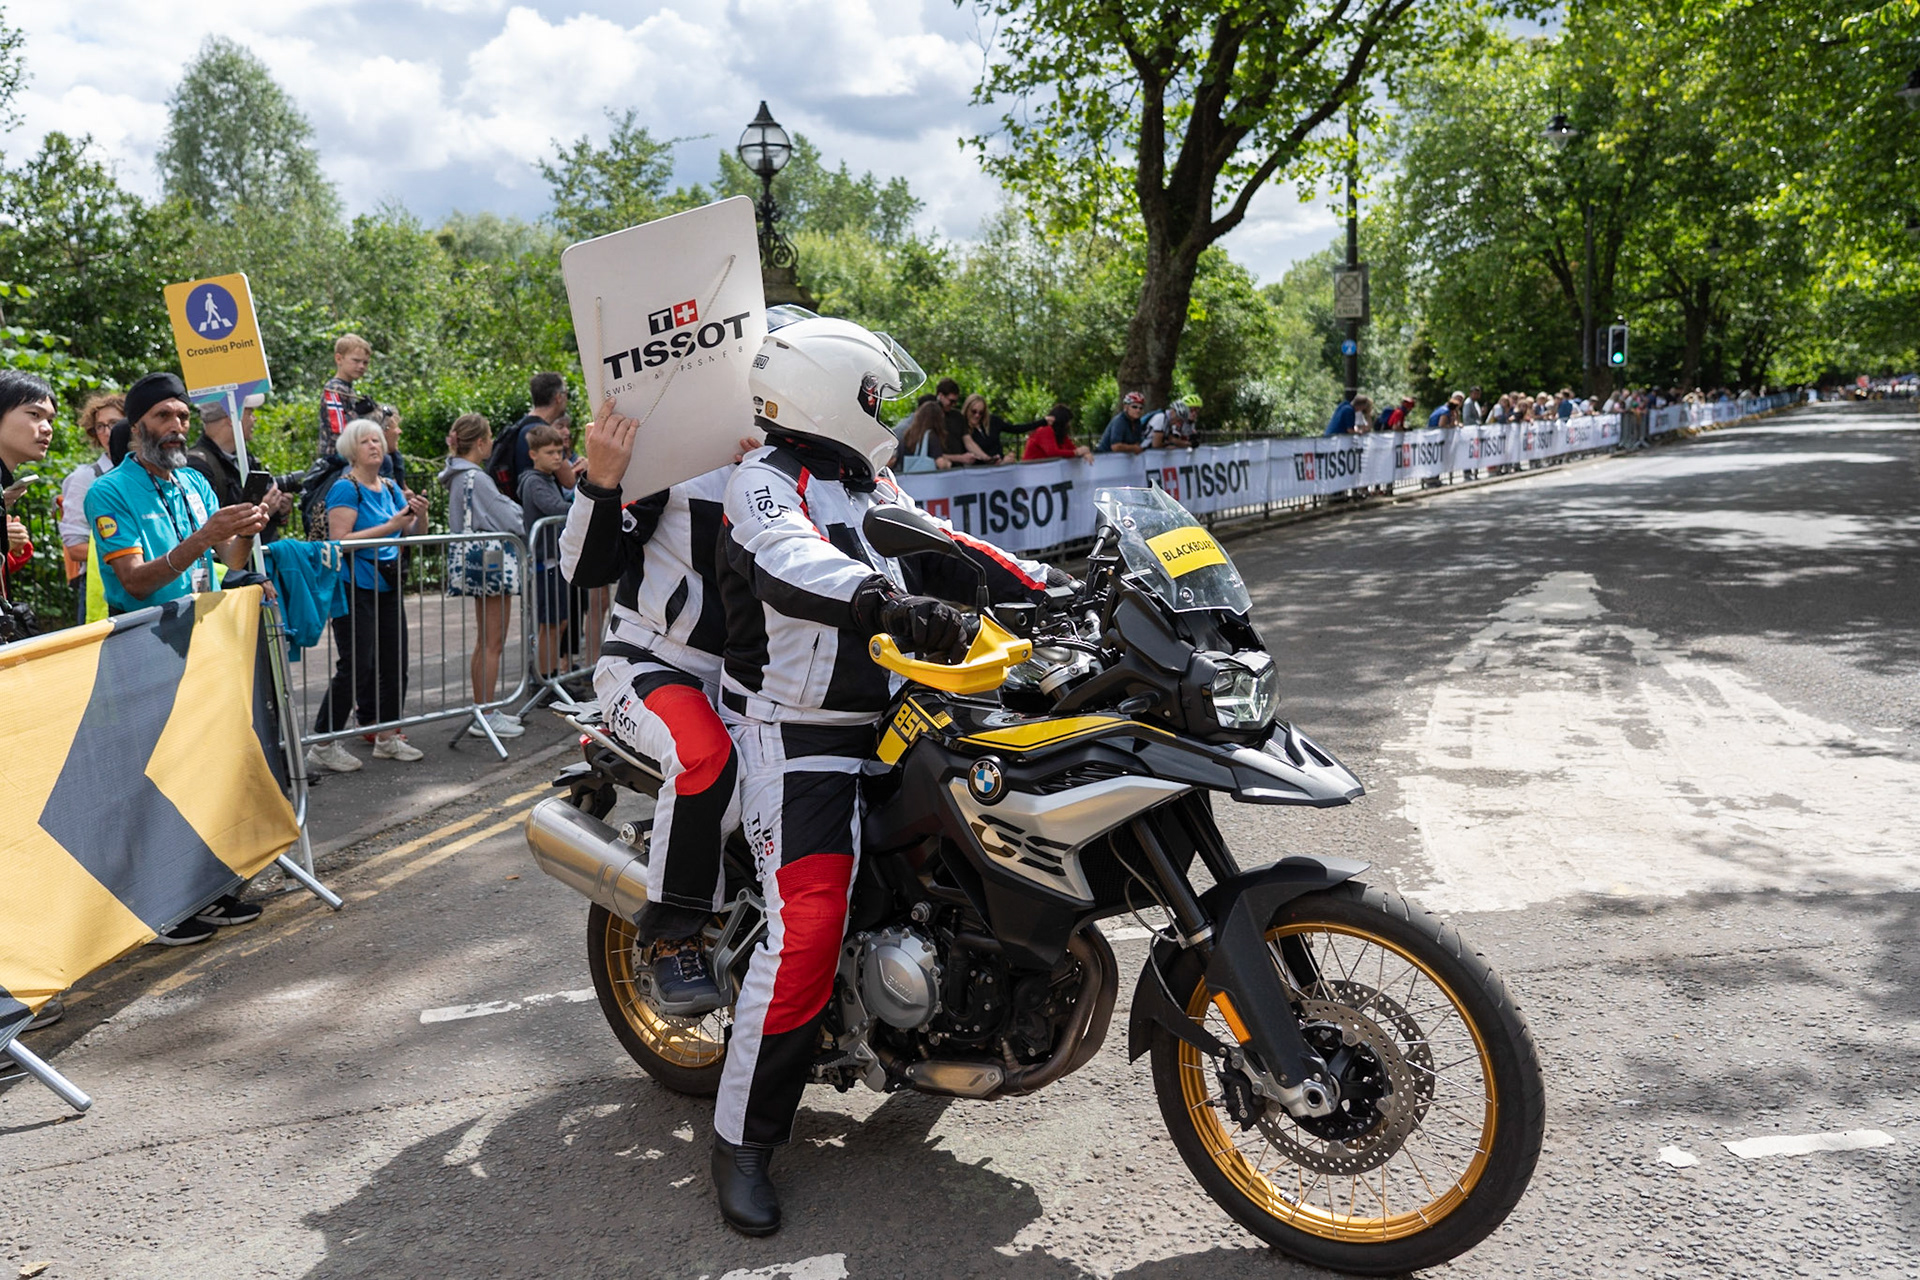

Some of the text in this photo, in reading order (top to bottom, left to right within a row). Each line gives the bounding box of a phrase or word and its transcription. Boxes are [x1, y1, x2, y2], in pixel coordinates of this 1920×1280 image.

[186, 339, 255, 357] Crossing Point
[603, 311, 750, 380] TISSOT
[1315, 448, 1364, 481] TISSOT
[1411, 440, 1445, 466] TISSOT
[1179, 459, 1250, 500] TISSOT
[953, 480, 1073, 536] TISSOT
